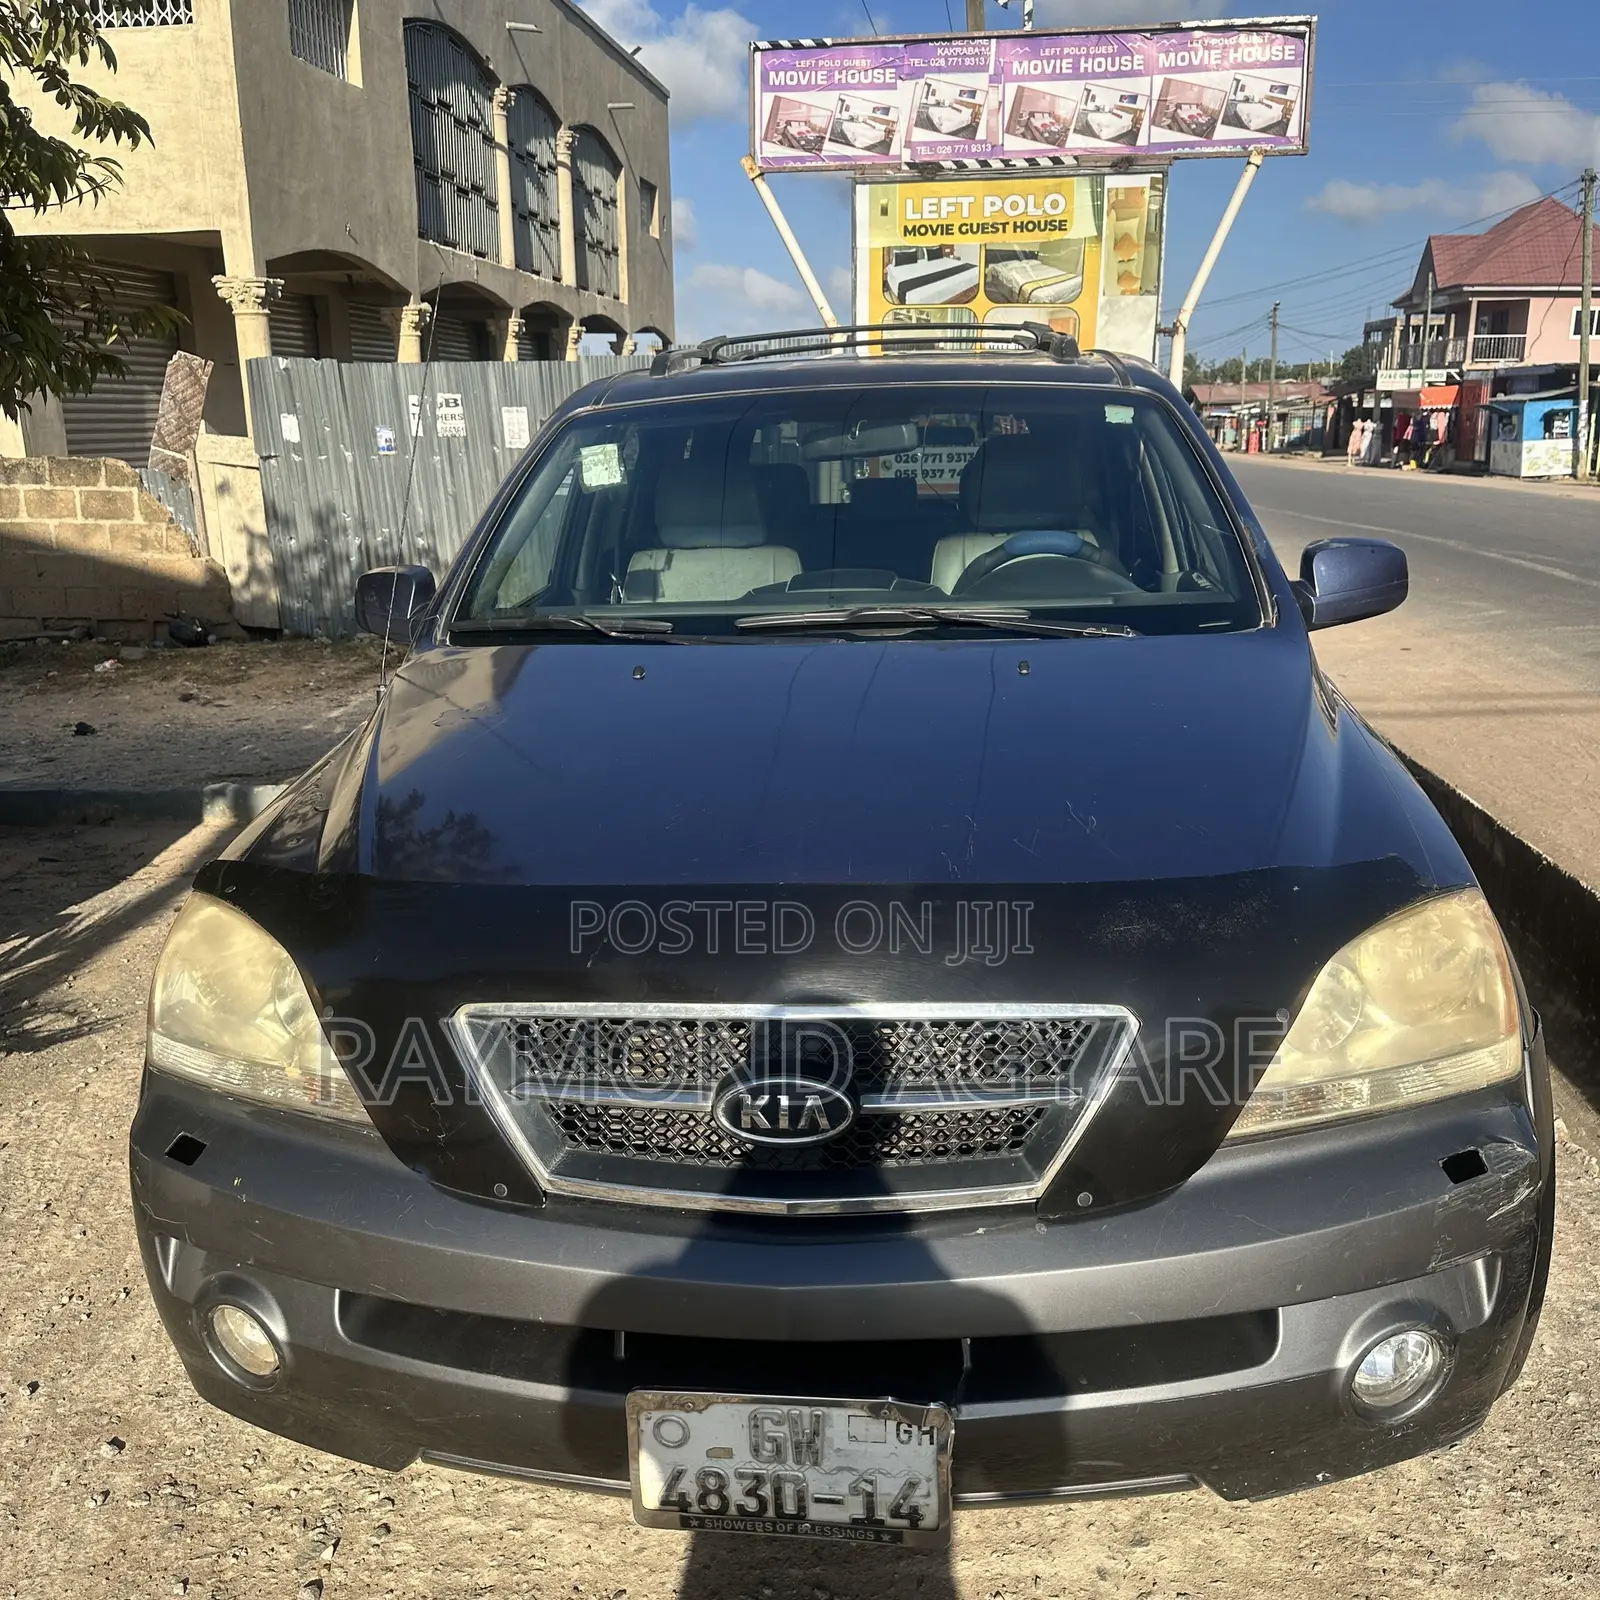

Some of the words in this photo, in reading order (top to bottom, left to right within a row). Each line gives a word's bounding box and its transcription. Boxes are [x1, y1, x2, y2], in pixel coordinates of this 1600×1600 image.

[1040, 47, 1061, 56] LEFT
[1063, 46, 1087, 55] POLO
[1089, 45, 1119, 54] GUEST
[1158, 49, 1222, 68] MOVIE
[1228, 45, 1295, 64] HOUSE
[796, 60, 816, 68] LEFT
[818, 59, 841, 68] POLO
[843, 59, 872, 67] GUEST
[908, 58, 928, 67] TEL:
[930, 58, 946, 67] 026
[947, 57, 962, 66] 771
[964, 57, 985, 66] 9313
[1012, 58, 1073, 75] MOVIE
[1080, 55, 1144, 73] HOUSE
[769, 70, 827, 86] MOVIE
[834, 68, 896, 84] HOUSE
[916, 146, 935, 155] TEL:
[937, 145, 952, 154] 026
[953, 144, 971, 154] 771
[971, 143, 991, 153] 9313
[905, 195, 976, 220] LEFT
[983, 192, 1068, 218] POLO
[903, 223, 954, 237] MOVIE
[958, 222, 1009, 235] GUEST
[1013, 219, 1068, 234] HOUSE
[894, 453, 919, 464] 026
[922, 453, 943, 464] 771
[946, 452, 975, 464] 9313
[894, 469, 918, 479] 055
[921, 469, 945, 479] 937
[739, 1094, 831, 1130] KIA
[748, 1407, 826, 1466] GW
[895, 1421, 937, 1446] GH
[658, 1464, 930, 1529] 4830-14
[704, 1518, 773, 1532] SHOWERS
[776, 1522, 794, 1533] OF
[797, 1523, 875, 1541] BLESSINGS
